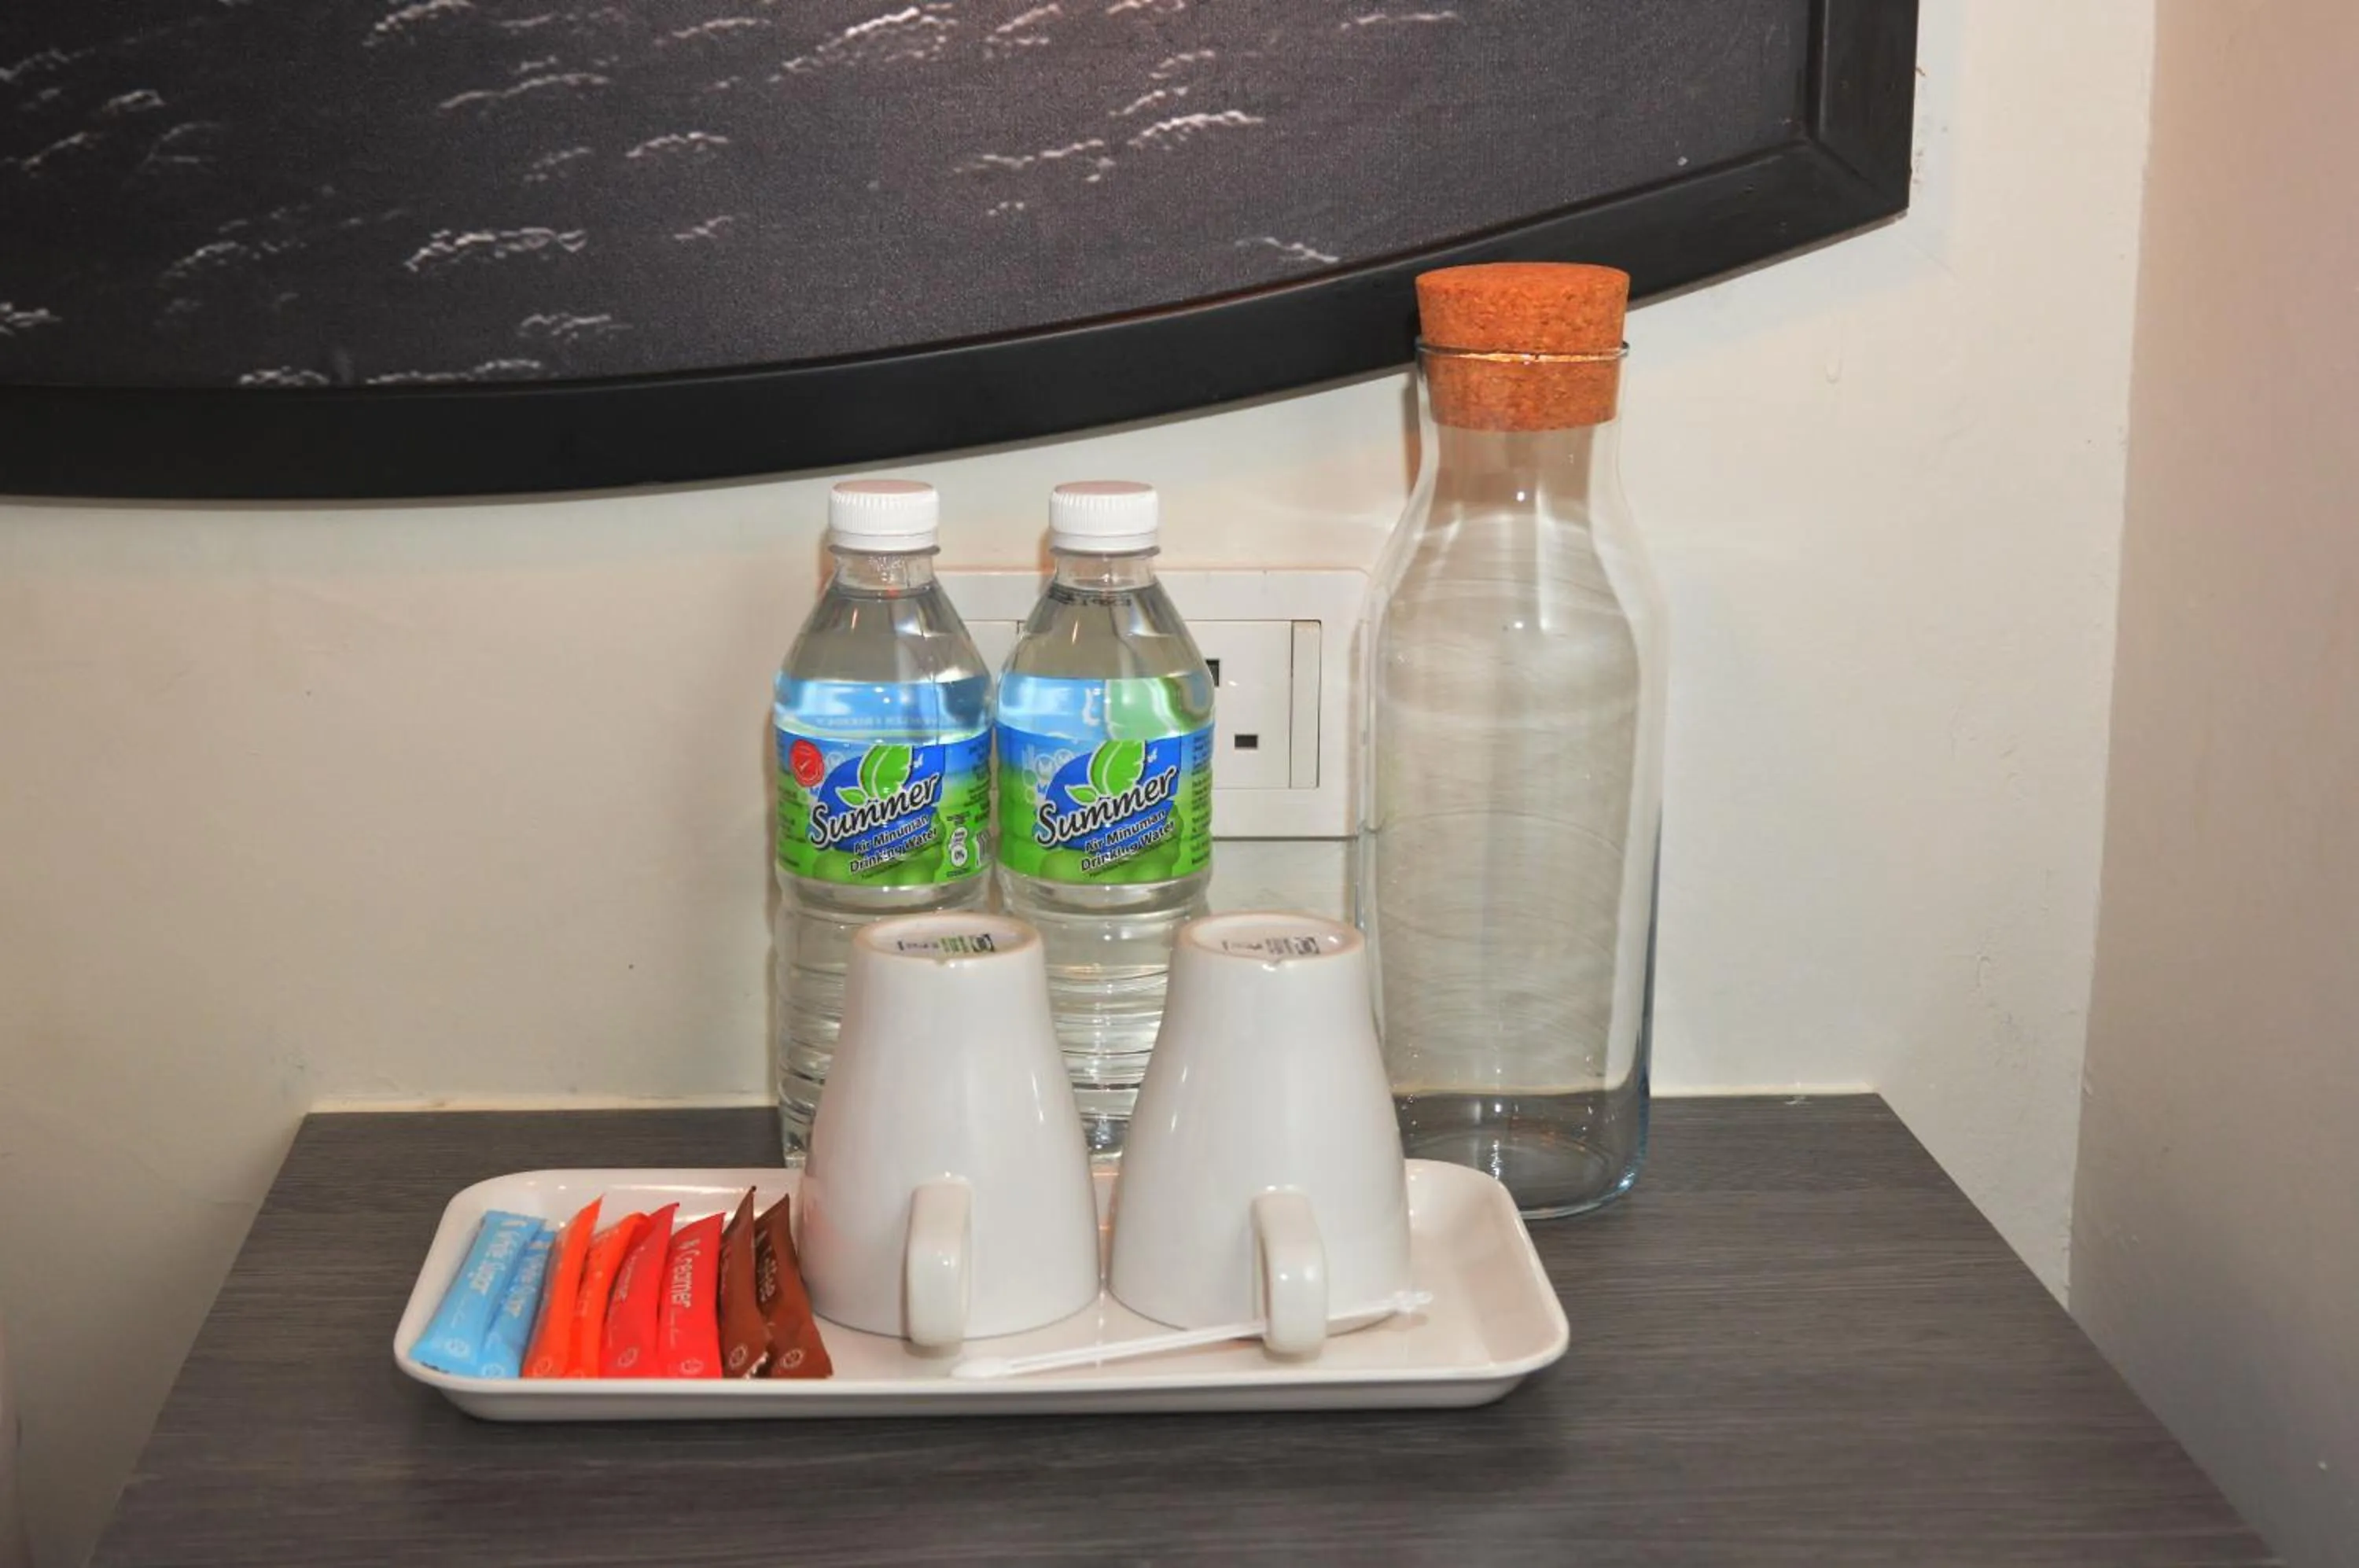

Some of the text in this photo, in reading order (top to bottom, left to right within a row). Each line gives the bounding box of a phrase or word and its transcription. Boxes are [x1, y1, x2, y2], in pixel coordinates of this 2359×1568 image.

[808, 773, 940, 851] Summer
[873, 815, 929, 848] Minuman
[1035, 766, 1178, 847] Summer
[1106, 811, 1165, 845] Minuman
